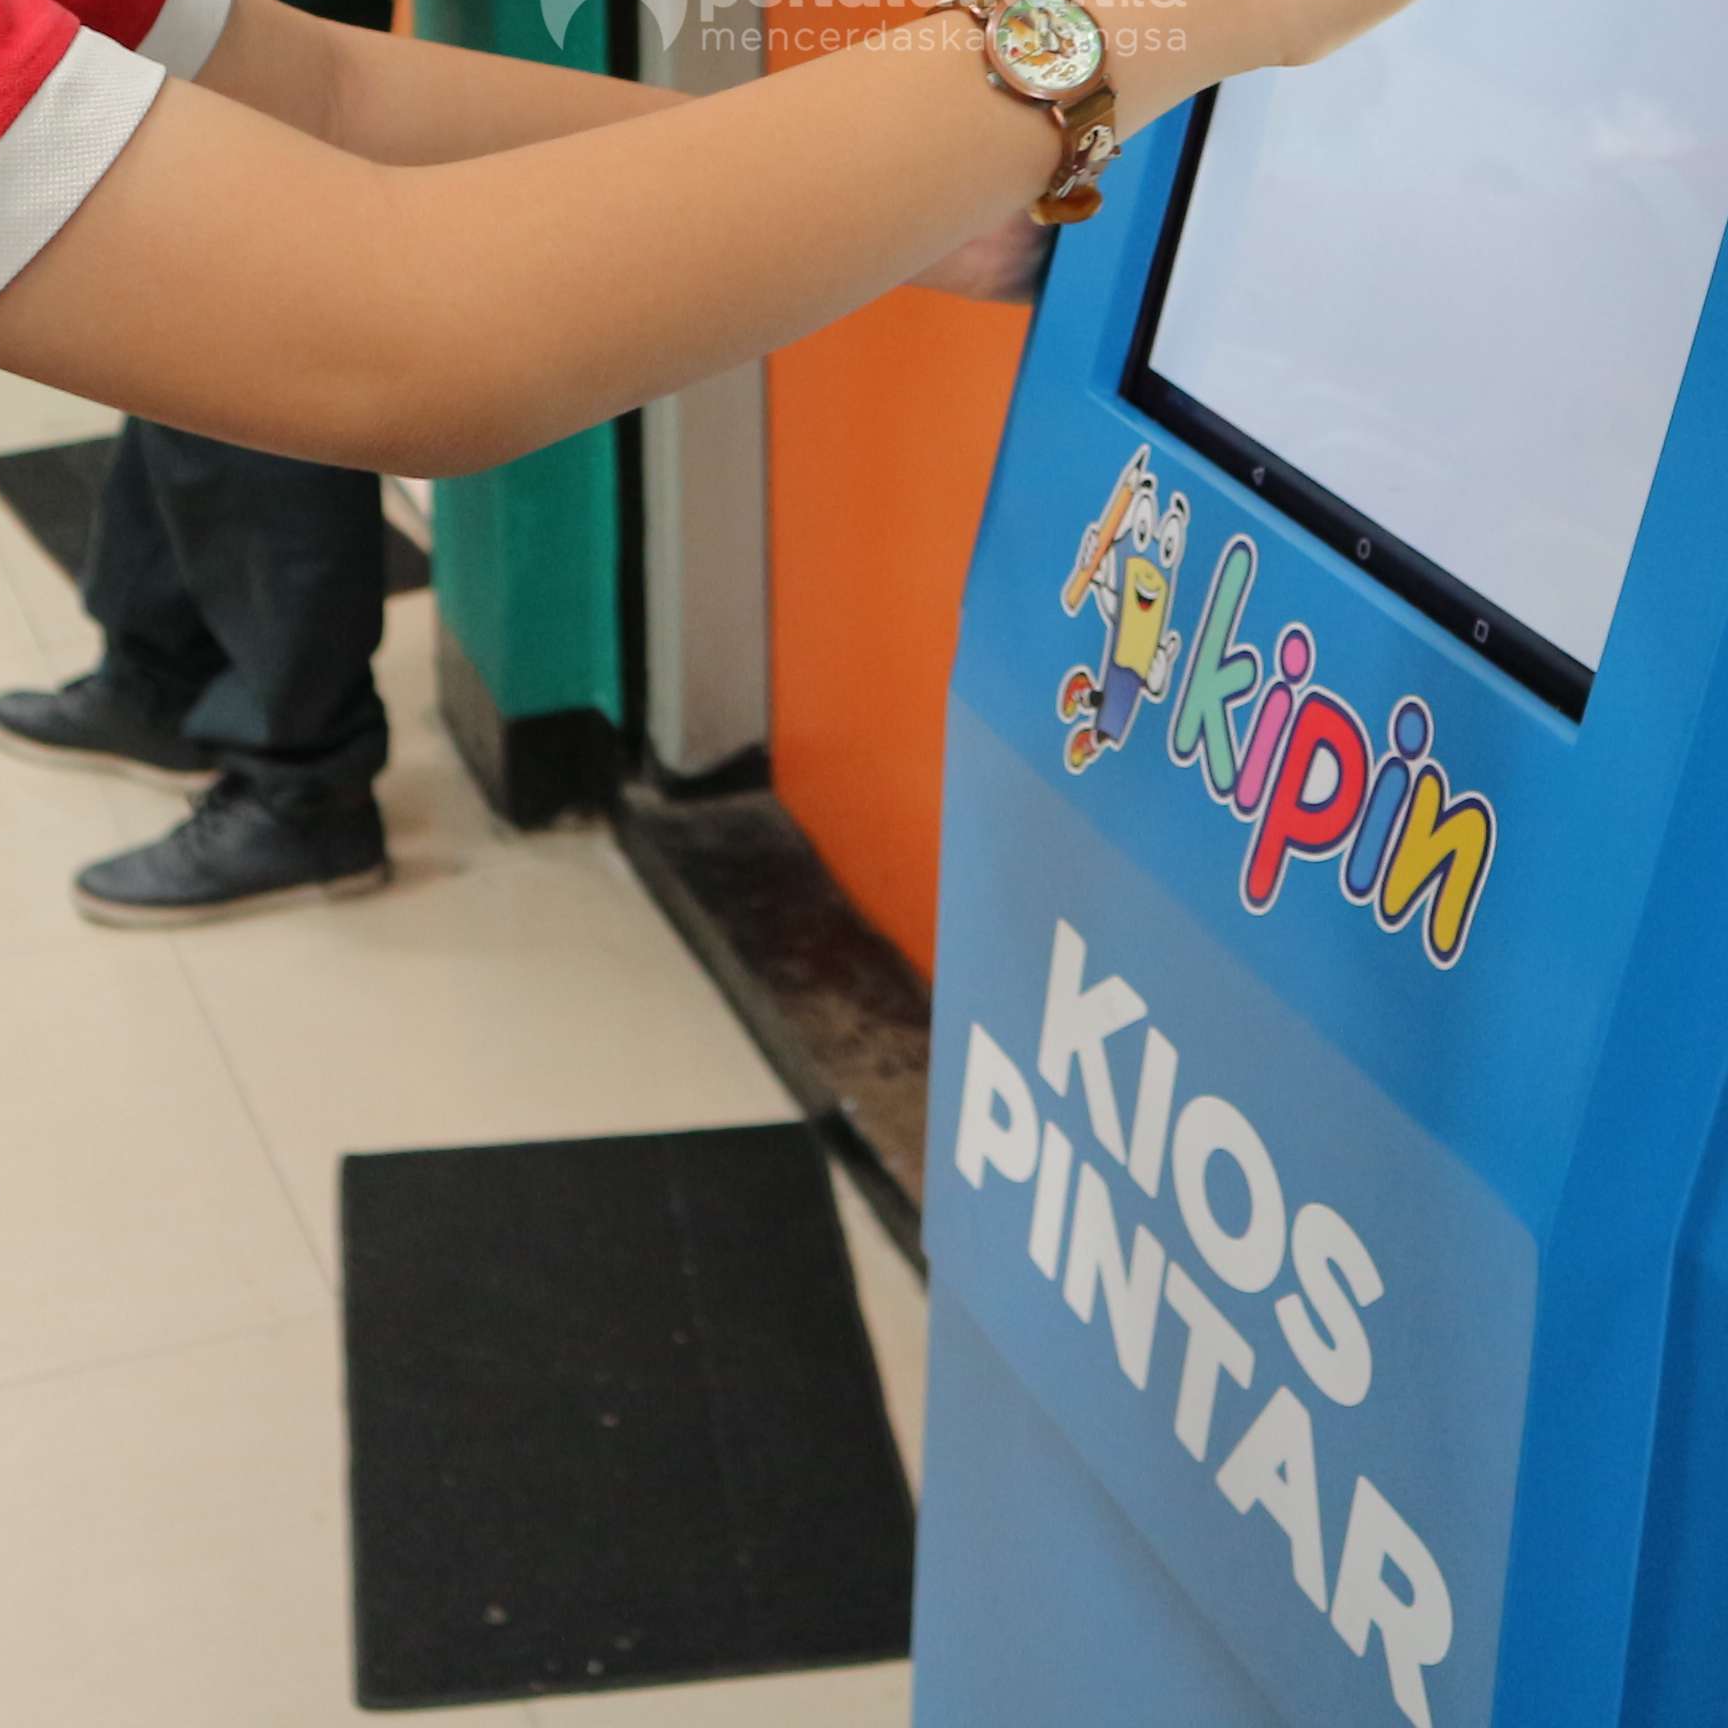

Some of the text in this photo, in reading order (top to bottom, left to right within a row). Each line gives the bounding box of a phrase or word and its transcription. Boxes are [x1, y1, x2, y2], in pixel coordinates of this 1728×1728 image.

[1168, 533, 1498, 970] kipin
[954, 1022, 1454, 1728] PINTAR
[1037, 917, 1385, 1407] KIOS
